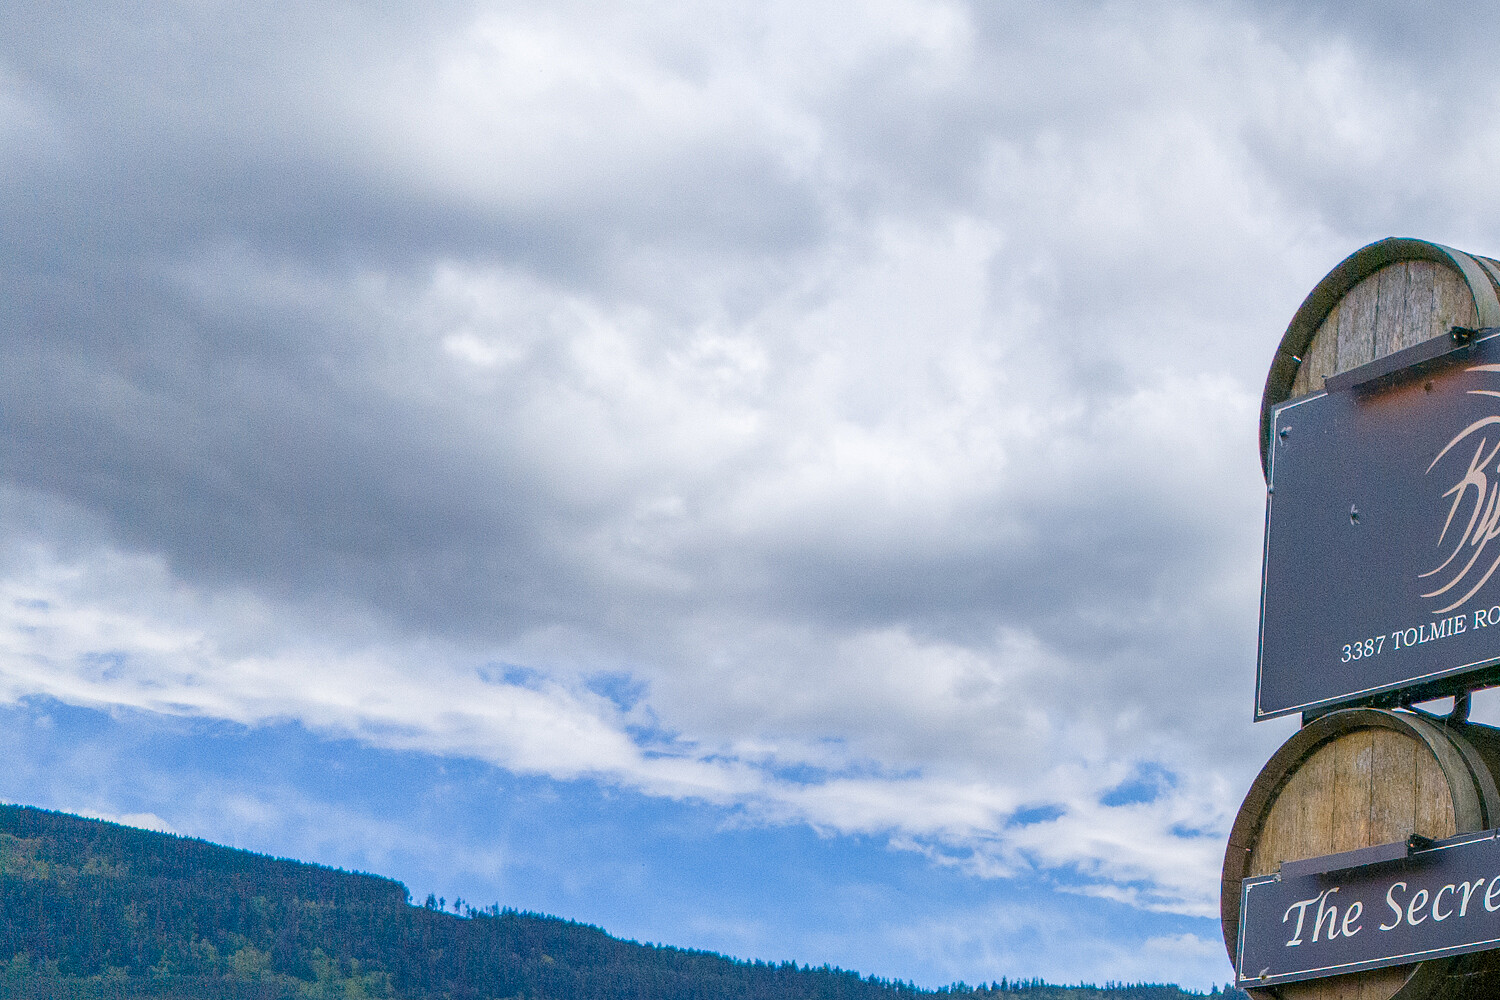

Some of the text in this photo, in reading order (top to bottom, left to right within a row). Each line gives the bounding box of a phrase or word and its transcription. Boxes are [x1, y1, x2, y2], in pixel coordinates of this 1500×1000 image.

[1340, 635, 1386, 664] 3387
[1391, 614, 1467, 650] TOLMIE
[1282, 887, 1363, 947] The
